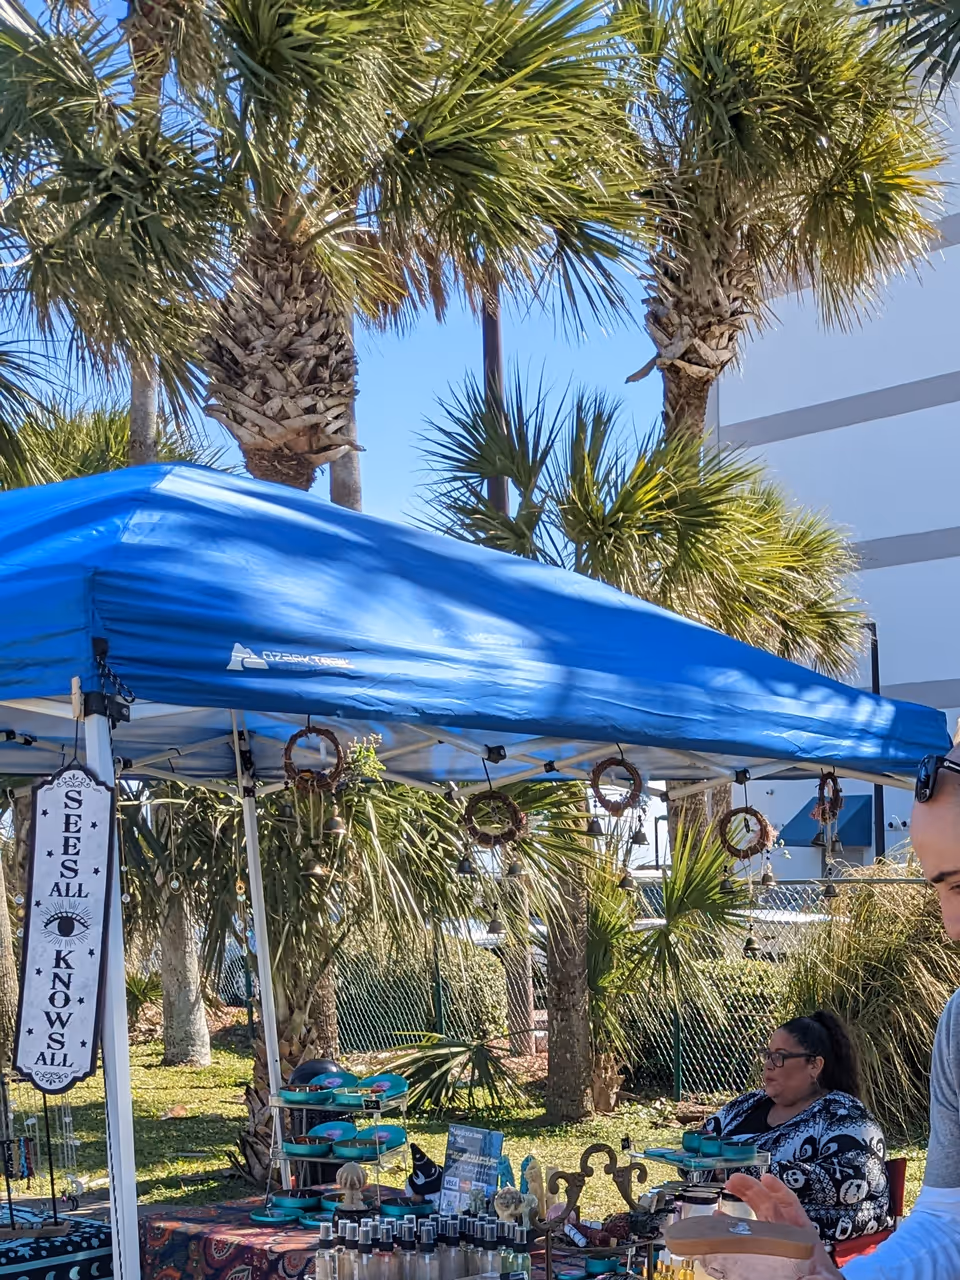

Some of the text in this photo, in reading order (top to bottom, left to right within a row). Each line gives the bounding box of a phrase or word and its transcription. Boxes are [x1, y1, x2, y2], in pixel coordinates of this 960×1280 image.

[60, 789, 83, 880] SEES
[48, 881, 91, 899] ALL
[43, 949, 75, 1051] KNOWS
[34, 1052, 75, 1068] ALL
